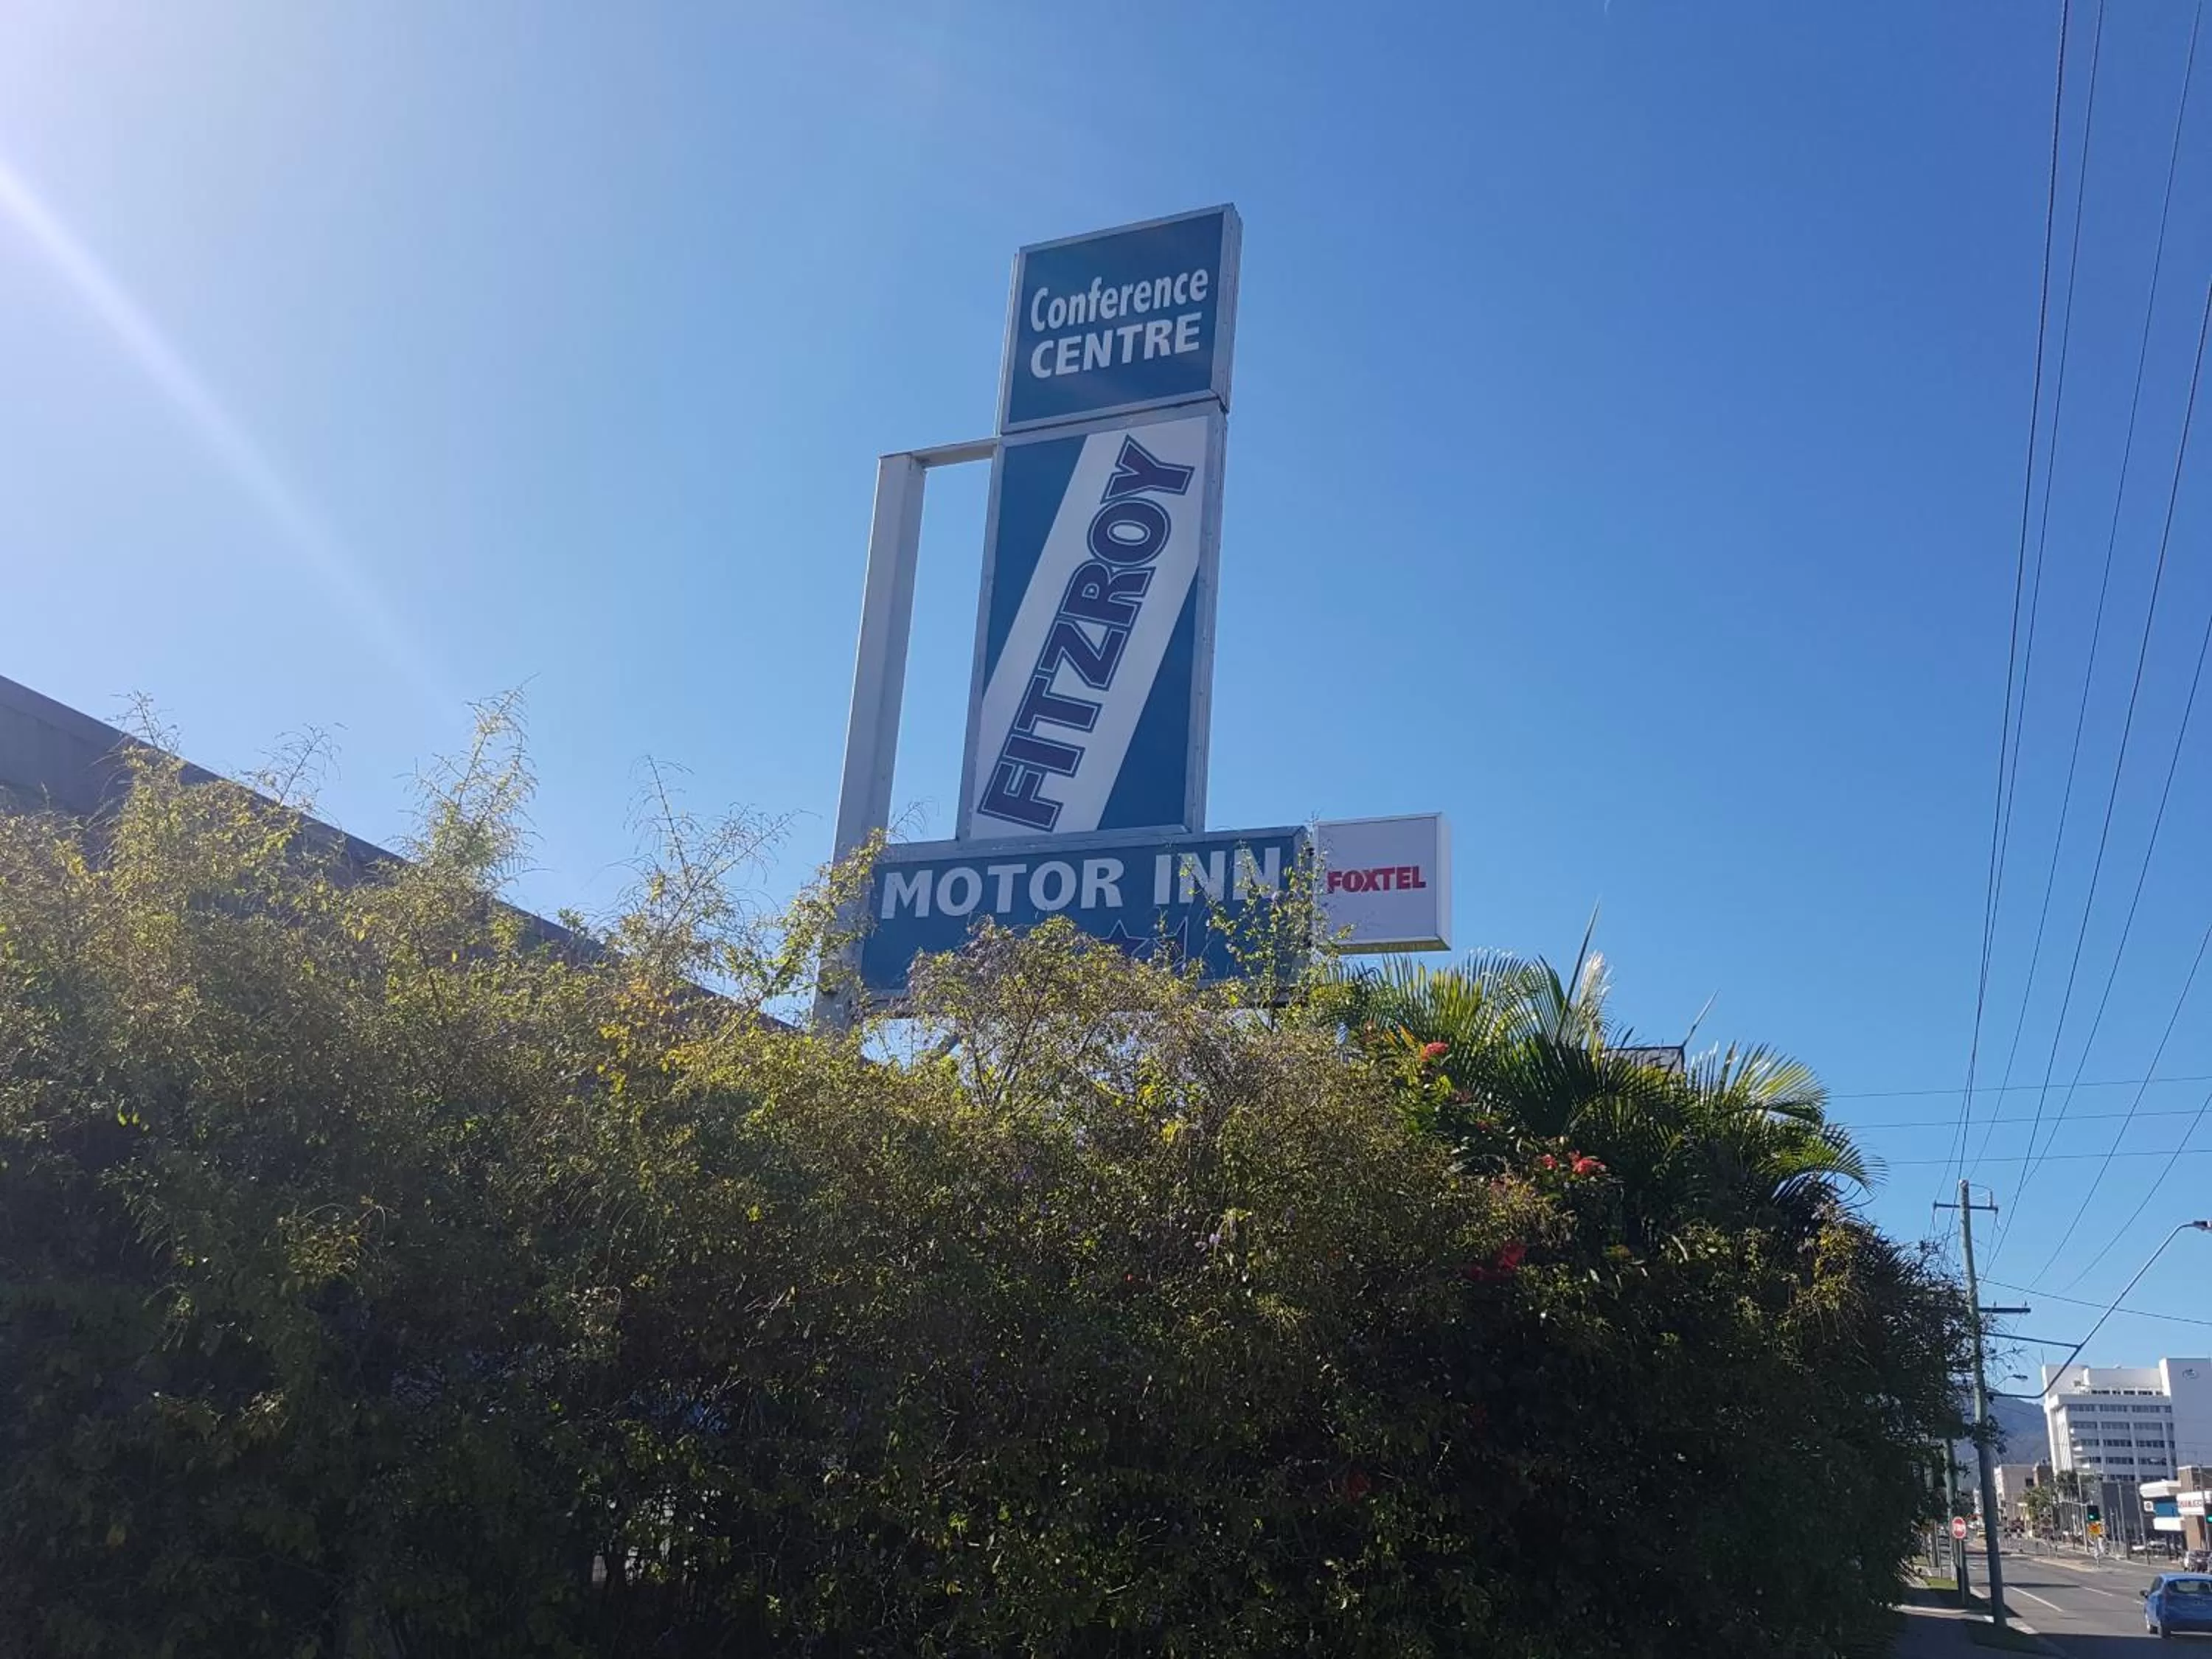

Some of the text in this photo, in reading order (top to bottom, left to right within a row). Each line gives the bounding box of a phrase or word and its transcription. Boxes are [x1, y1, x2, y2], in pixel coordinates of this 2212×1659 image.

[1030, 268, 1209, 333] Conference
[1030, 311, 1203, 379] CENTRE
[977, 434, 1195, 833] FITZROY
[880, 846, 1281, 919] MOTOR INN
[1327, 865, 1427, 894] FOXTEL
